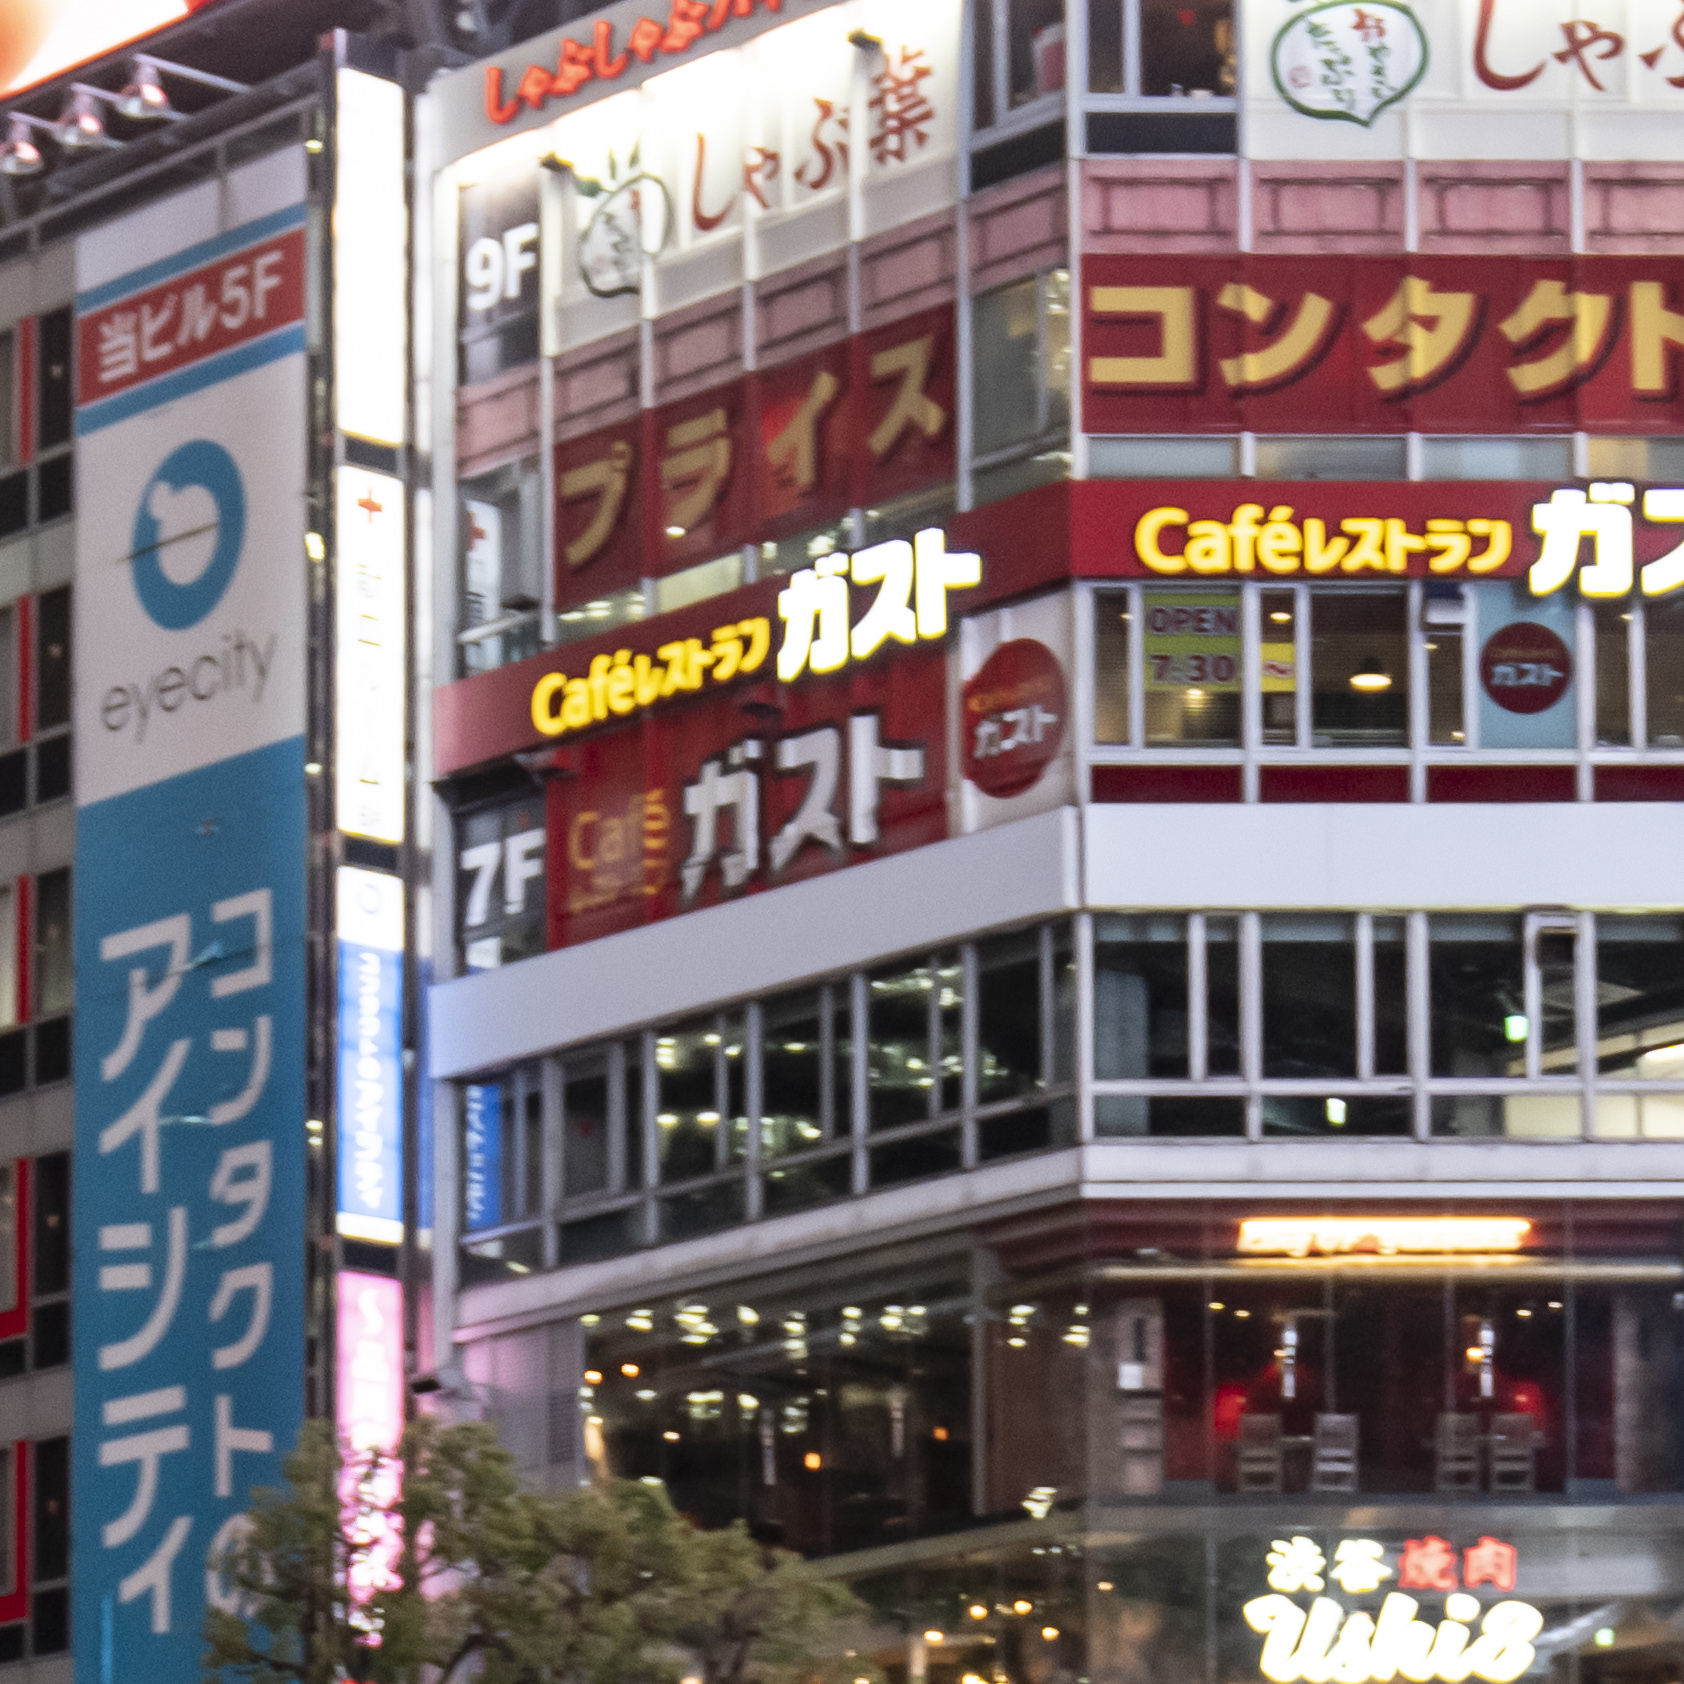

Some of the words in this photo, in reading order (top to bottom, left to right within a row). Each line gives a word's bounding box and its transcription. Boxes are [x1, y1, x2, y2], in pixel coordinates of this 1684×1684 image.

[486, 0, 782, 124] しゃぶしゃぶ
[466, 222, 538, 311] 9F
[97, 271, 282, 384] 当ビル5F
[563, 335, 946, 568] プライス
[777, 527, 982, 682] ガスト
[1150, 607, 1239, 636] OPEN
[102, 632, 279, 743] eyecity
[682, 714, 925, 897] ガスト
[461, 830, 545, 926] 7F
[98, 912, 193, 1633] アイシティ
